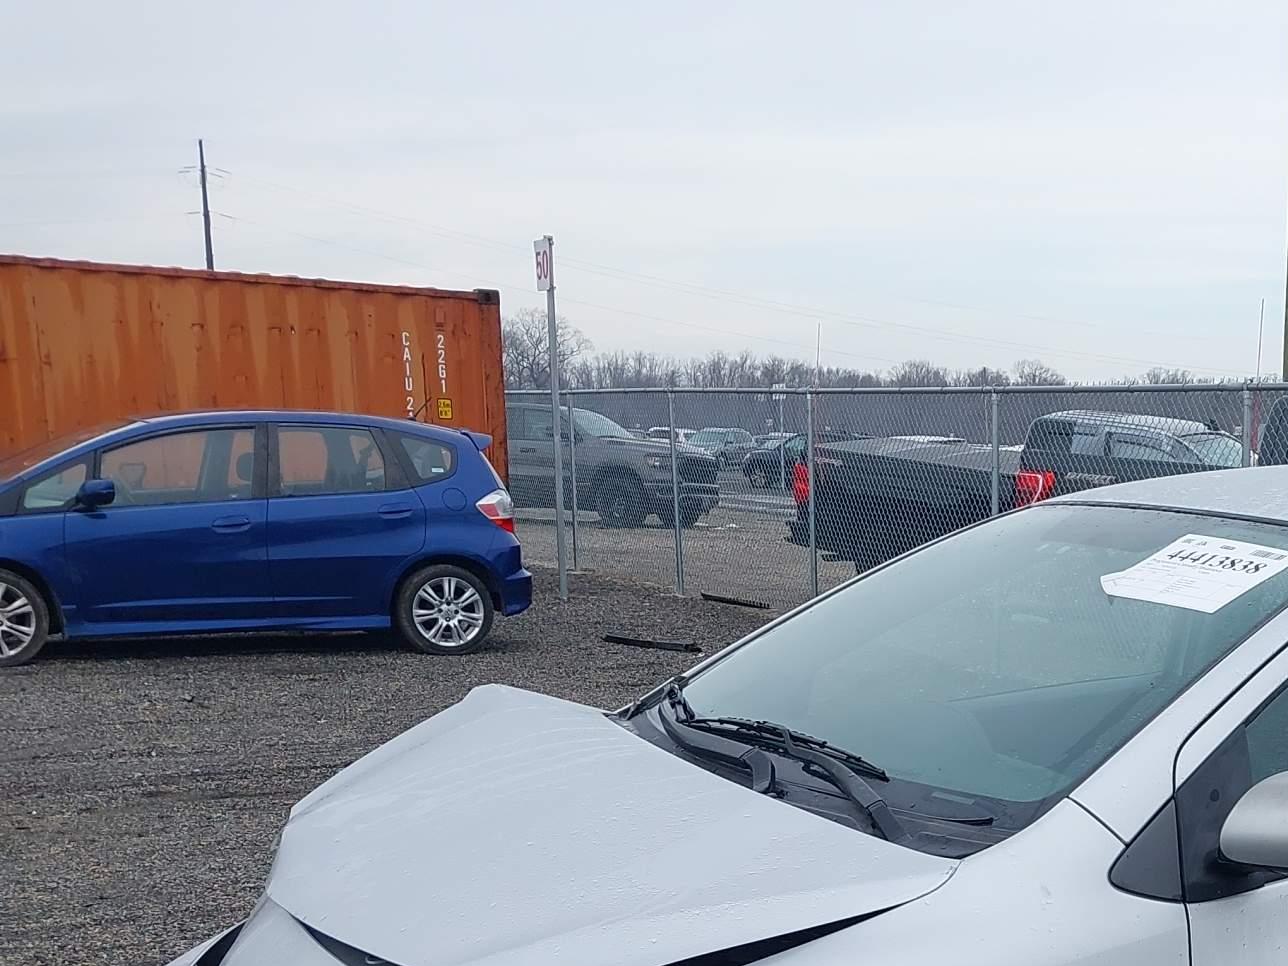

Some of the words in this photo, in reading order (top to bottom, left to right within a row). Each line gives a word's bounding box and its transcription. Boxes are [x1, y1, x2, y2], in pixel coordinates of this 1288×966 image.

[536, 250, 549, 280] 50
[402, 332, 412, 391] CAIU
[437, 335, 446, 393] 22G1
[1167, 549, 1267, 574] 44413838
